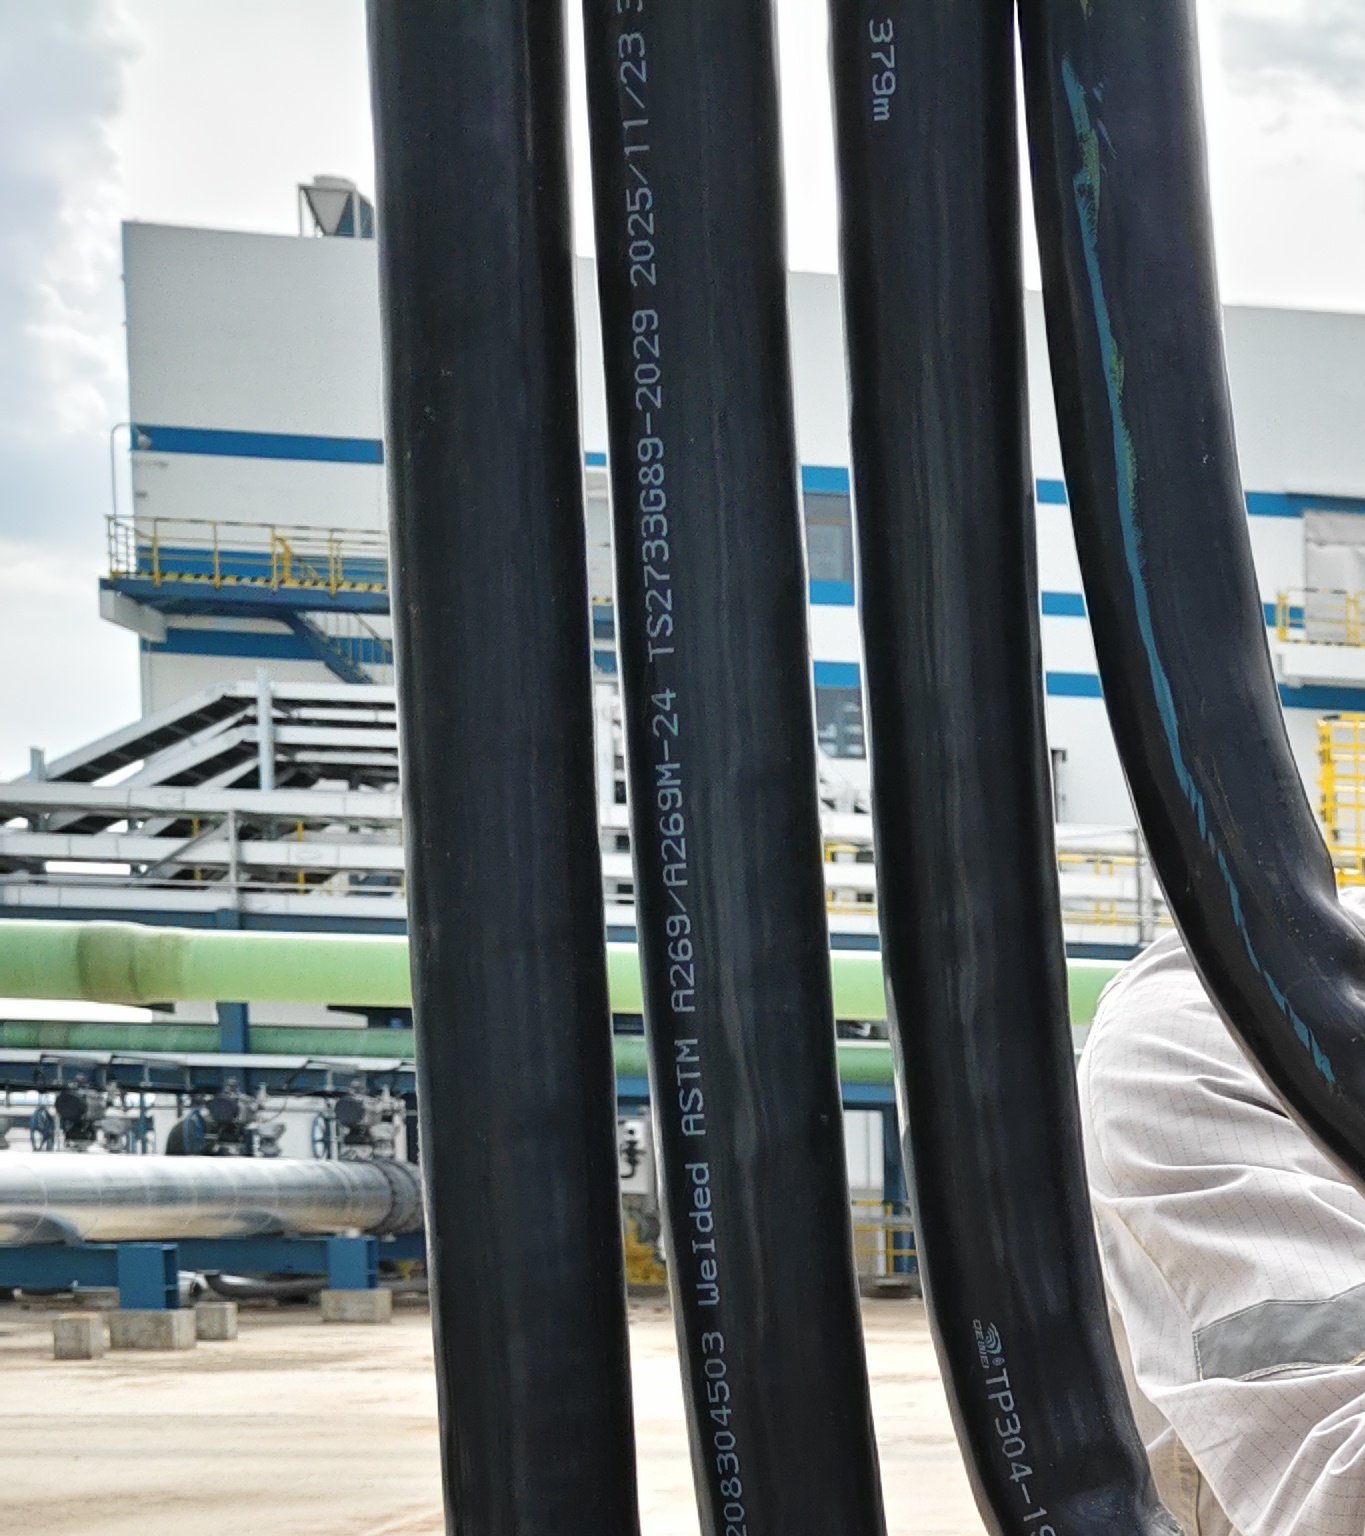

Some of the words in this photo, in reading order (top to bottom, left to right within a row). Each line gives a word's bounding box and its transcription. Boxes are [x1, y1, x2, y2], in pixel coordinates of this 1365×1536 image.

[618, 32, 657, 287] 2025/11/23
[869, 18, 896, 121] 379m
[632, 308, 675, 663] TS2733G89-2029
[651, 687, 695, 1013] A269/A269M-24
[674, 1038, 706, 1136] ASTM
